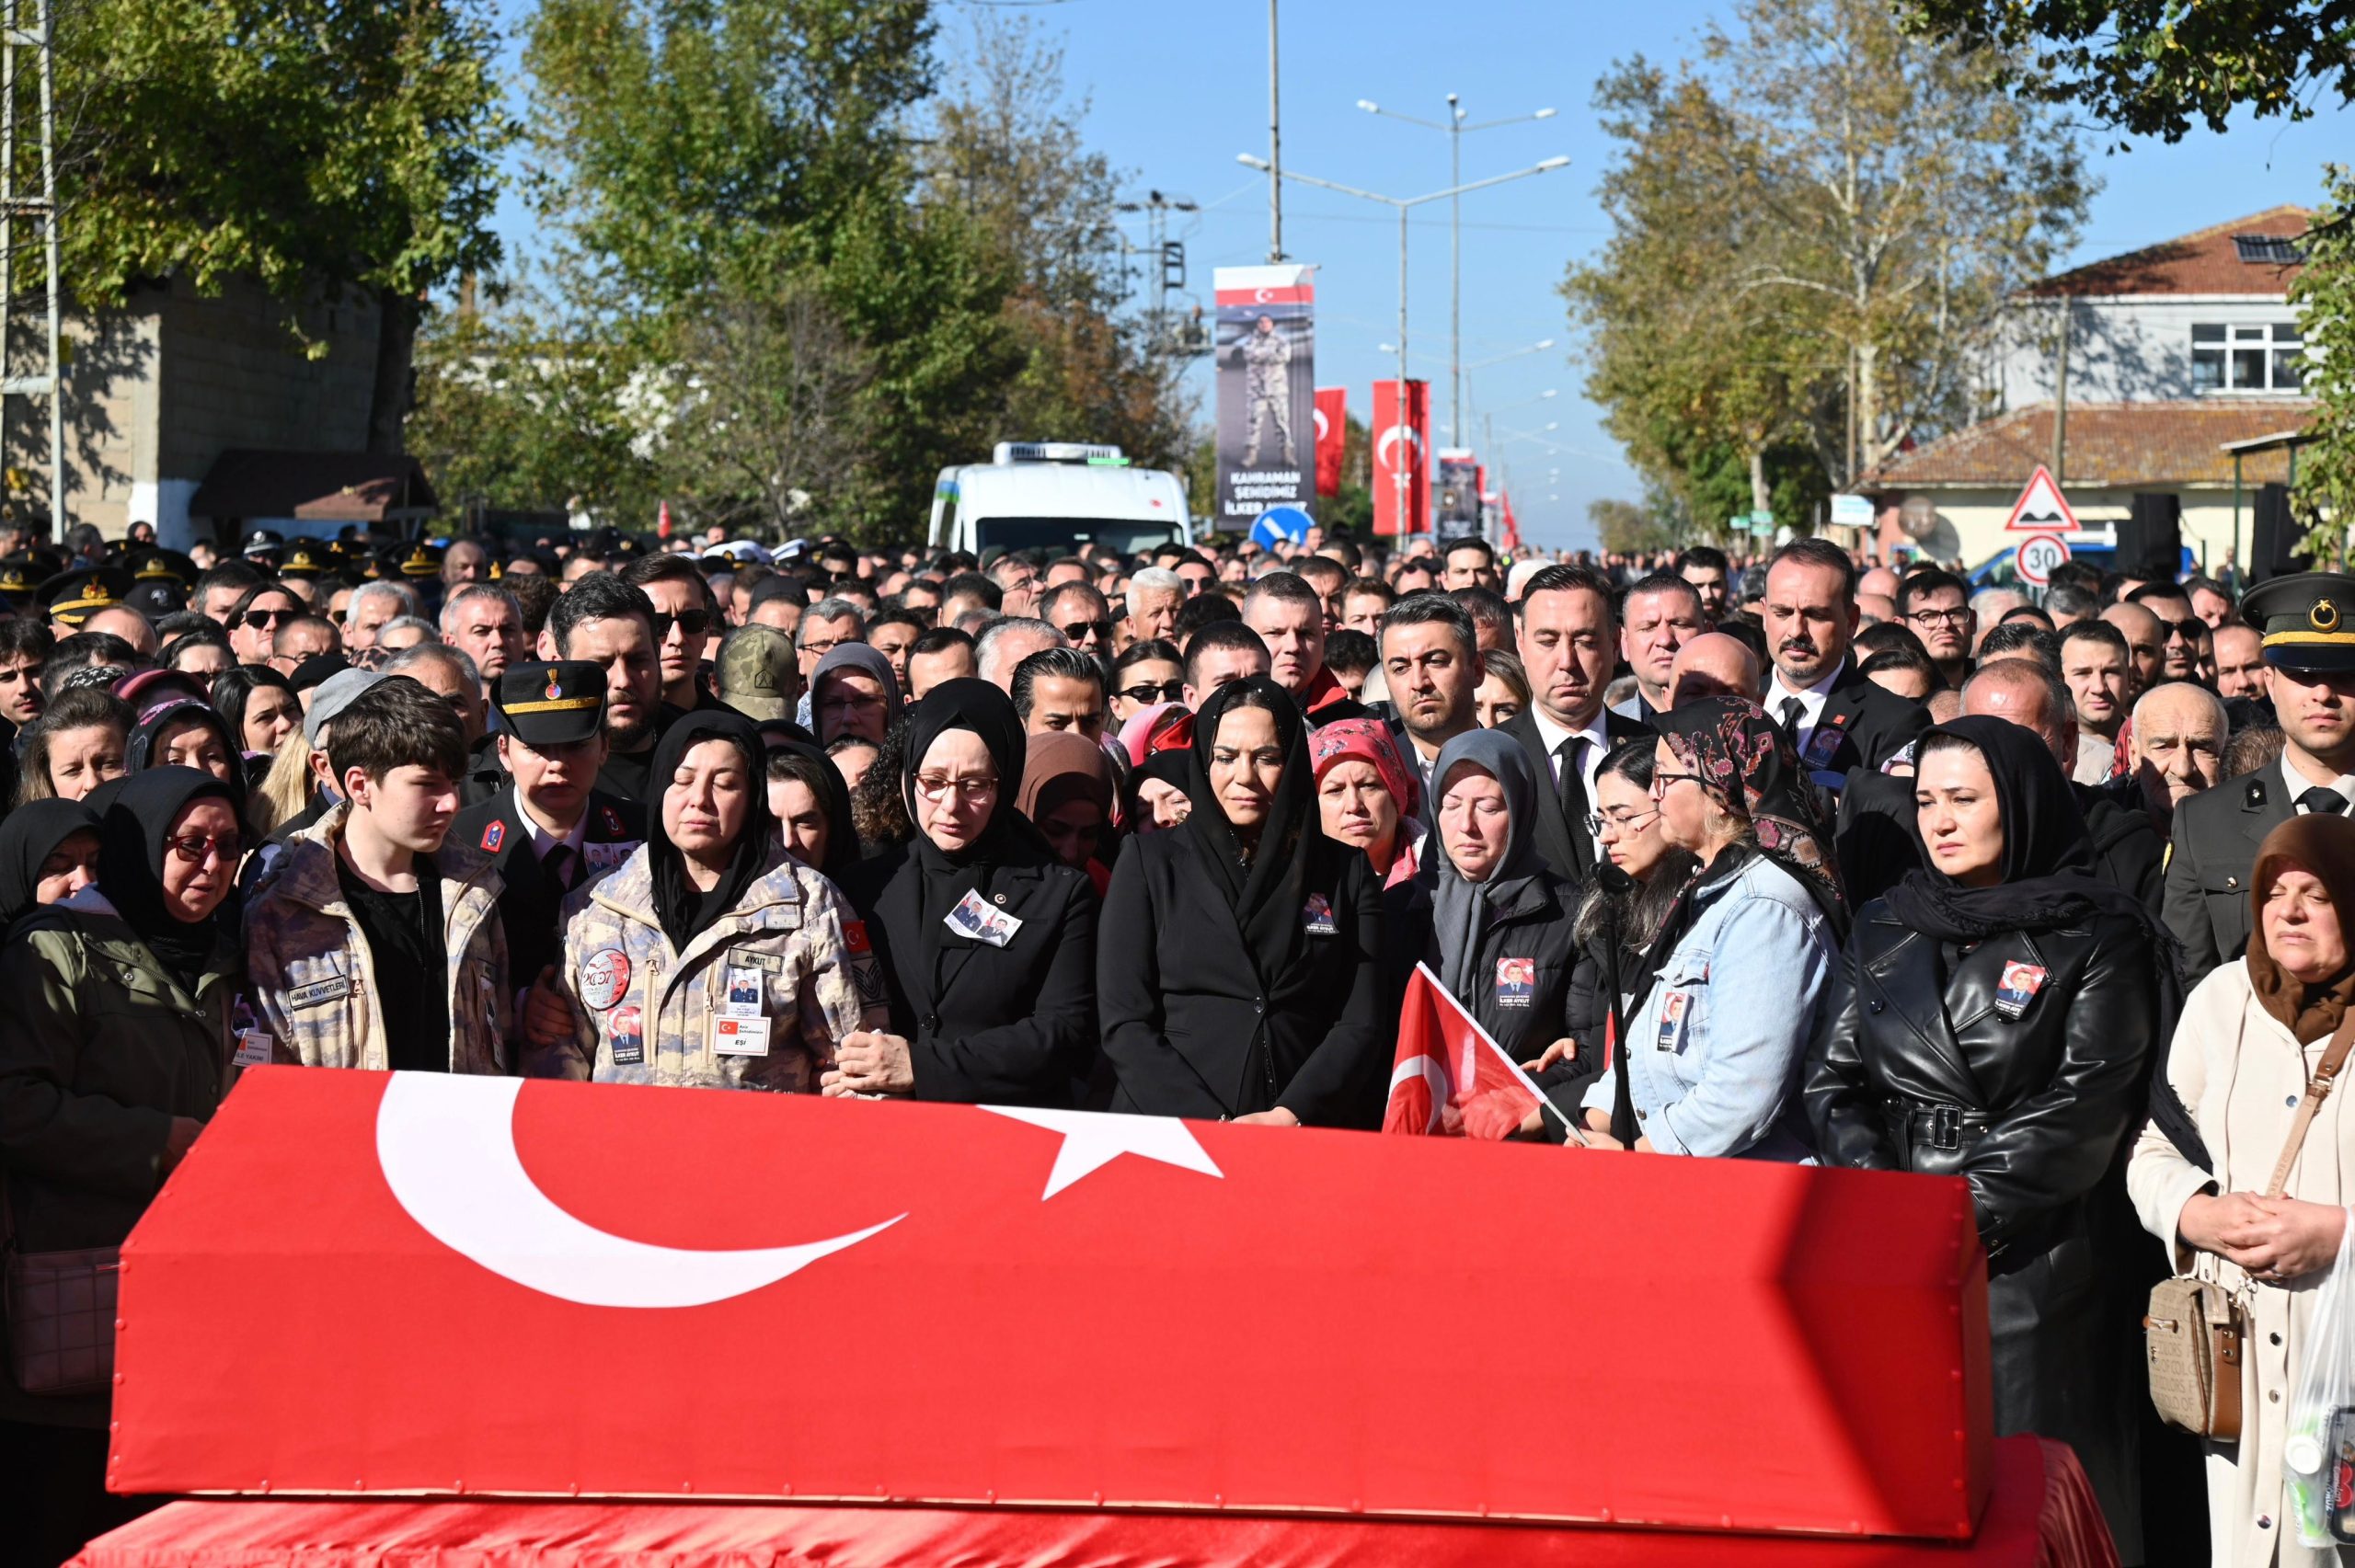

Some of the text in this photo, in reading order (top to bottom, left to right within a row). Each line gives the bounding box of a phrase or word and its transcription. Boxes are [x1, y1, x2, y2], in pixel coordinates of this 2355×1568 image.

[1231, 471, 1301, 485] KAHRAMAN
[1235, 485, 1297, 500] ŞEHİDİMİZ
[1224, 499, 1264, 515] İLKER
[2029, 549, 2056, 568] 30
[745, 956, 766, 966] AYKUT
[291, 980, 346, 1002] HAVA KUVVETLERİ
[735, 1037, 747, 1047] EŞİ
